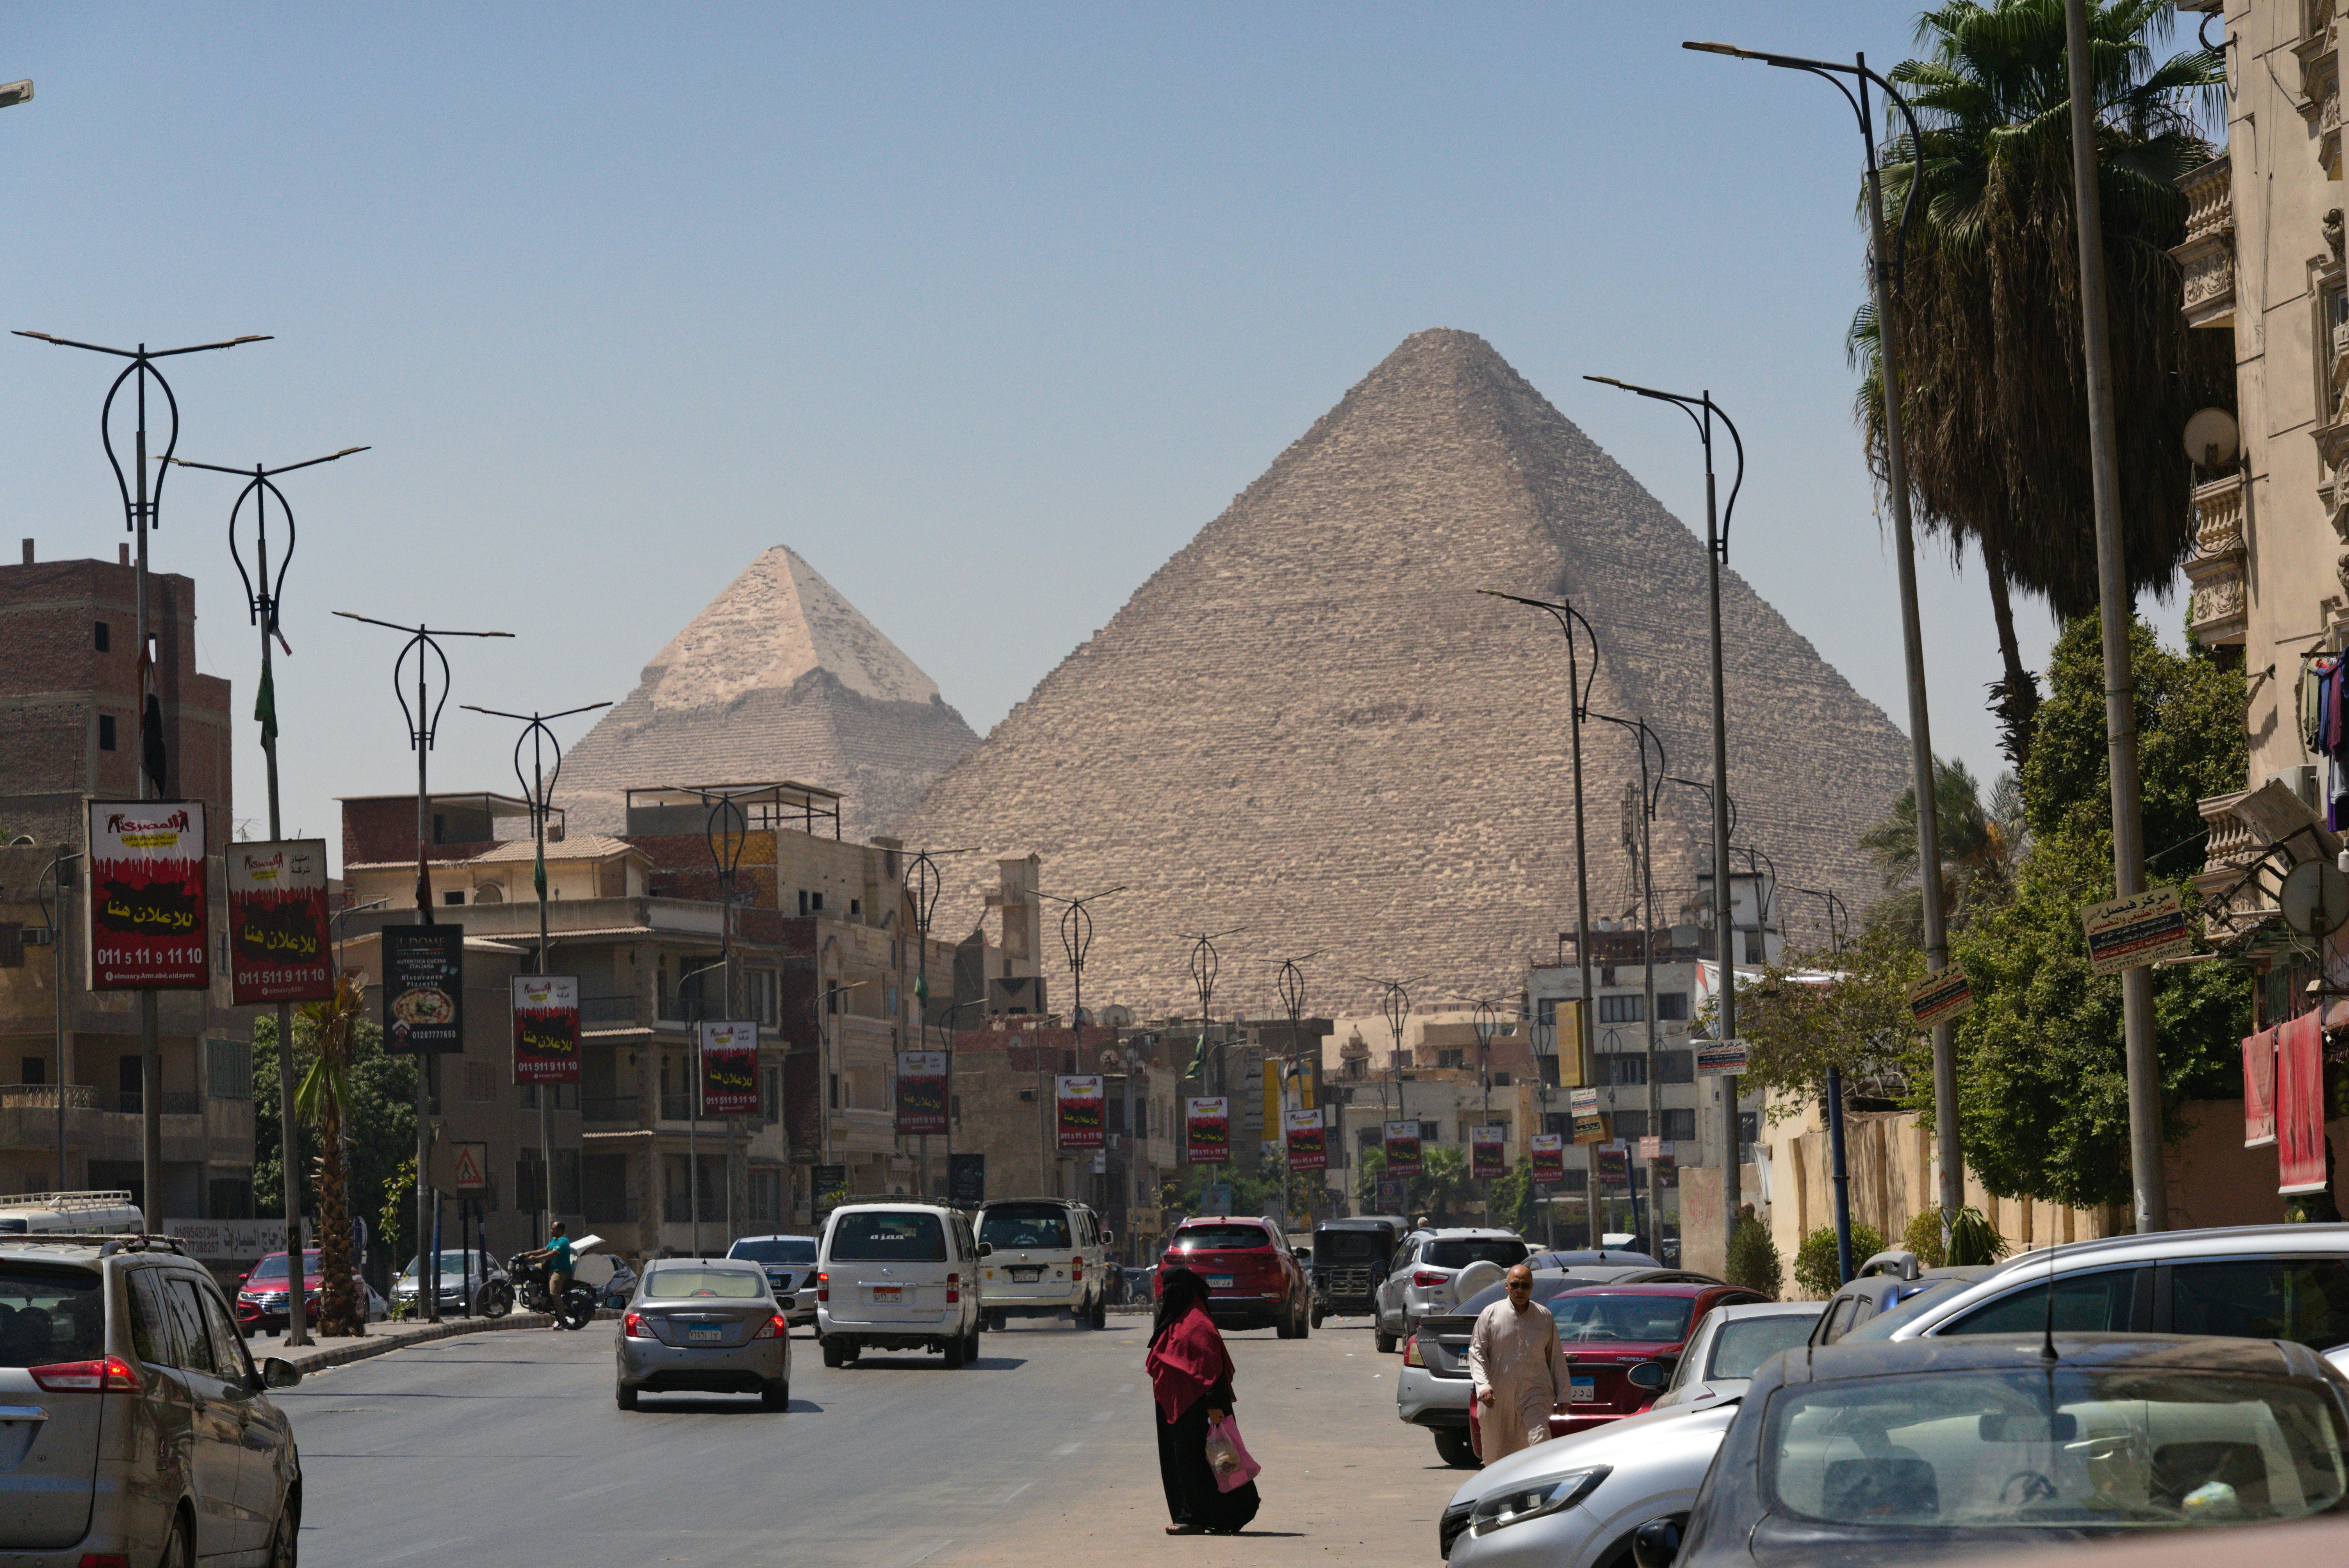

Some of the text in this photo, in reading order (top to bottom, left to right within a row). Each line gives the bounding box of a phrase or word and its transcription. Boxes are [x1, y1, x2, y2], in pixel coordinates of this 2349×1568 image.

[2101, 893, 2169, 918] مركز فيصل
[2157, 902, 2175, 915] للعلاج
[108, 900, 193, 930] للإعلان هنا
[245, 925, 317, 956] للإعلان هنا
[98, 948, 202, 965] 011 5 11 9 11 10
[239, 968, 325, 985] 011 511 9 11 10
[1917, 966, 1958, 990] مركز فيصل
[523, 1030, 536, 1043] هنا
[519, 1061, 577, 1071] 011 511 9 11 10
